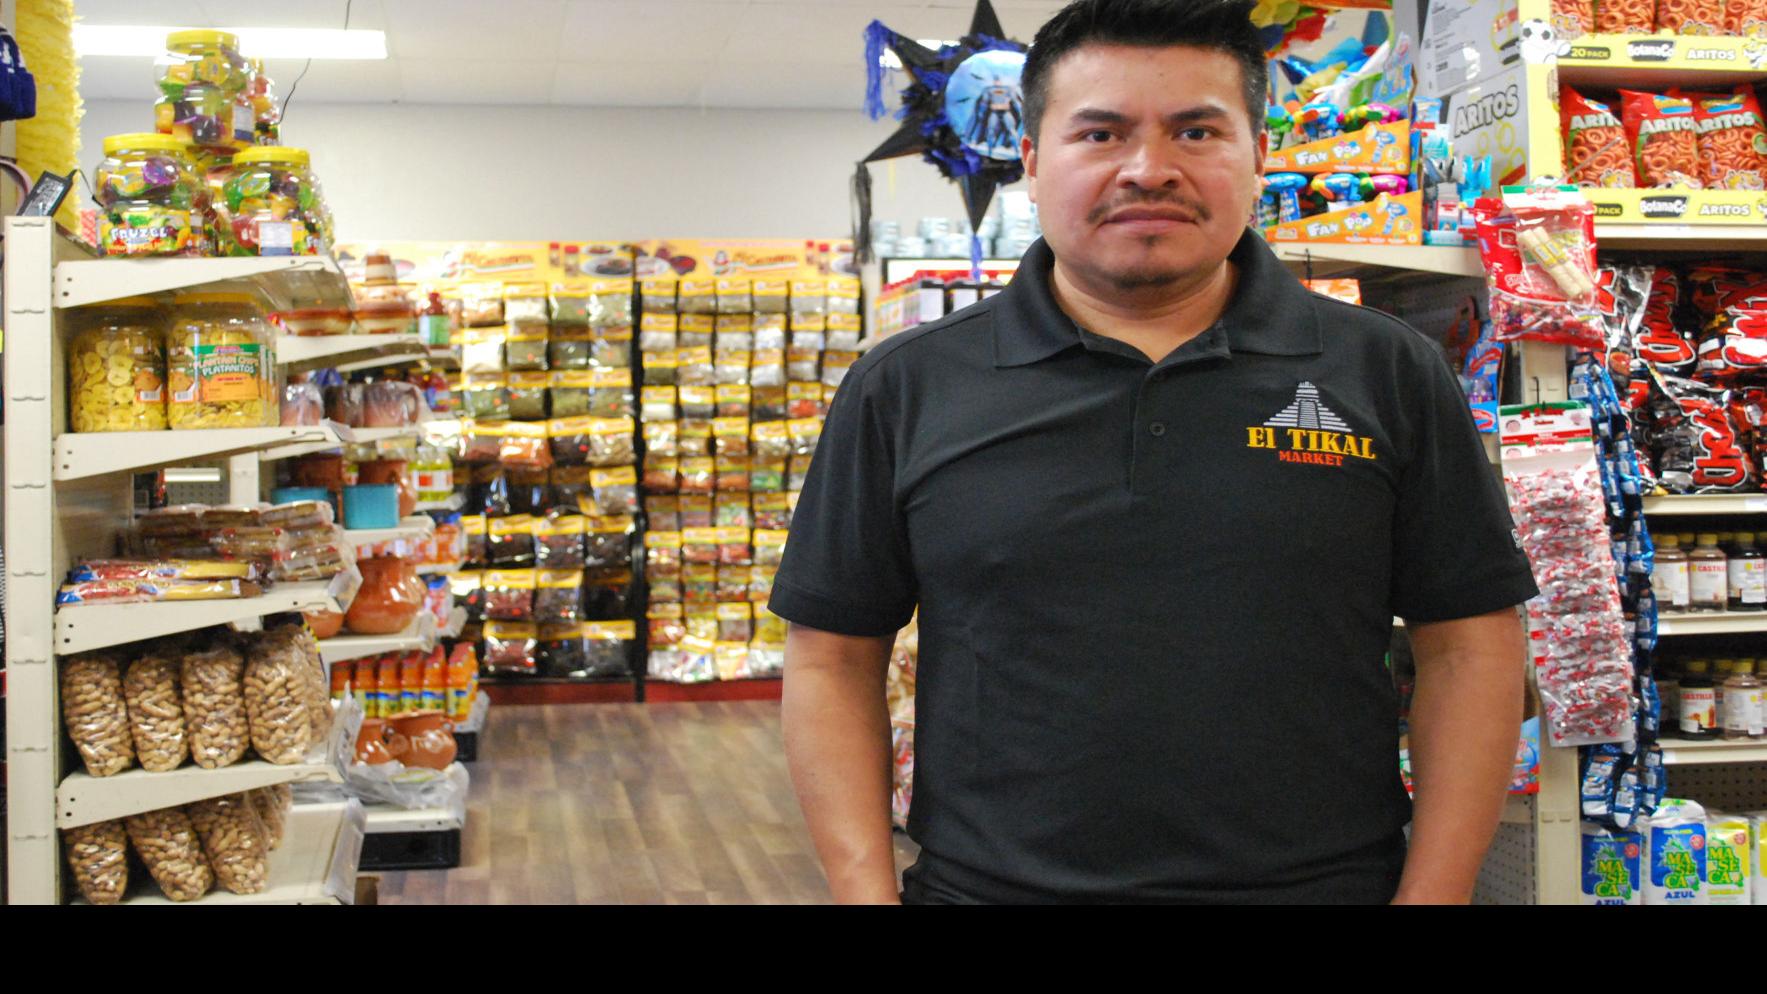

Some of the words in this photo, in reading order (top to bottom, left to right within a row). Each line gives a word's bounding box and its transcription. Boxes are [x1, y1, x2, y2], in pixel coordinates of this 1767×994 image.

[1571, 48, 1586, 57] 20
[1686, 48, 1736, 60] ARITOS
[1454, 84, 1519, 139] ARITOS
[1640, 117, 1695, 134] ARITO
[1599, 207, 1621, 215] PACK
[1698, 203, 1750, 216] ARITOS
[202, 363, 256, 377] PLATANITOS
[1287, 428, 1376, 459] TIKAL
[1279, 450, 1344, 466] MARKET
[1664, 890, 1695, 900] AZUL
